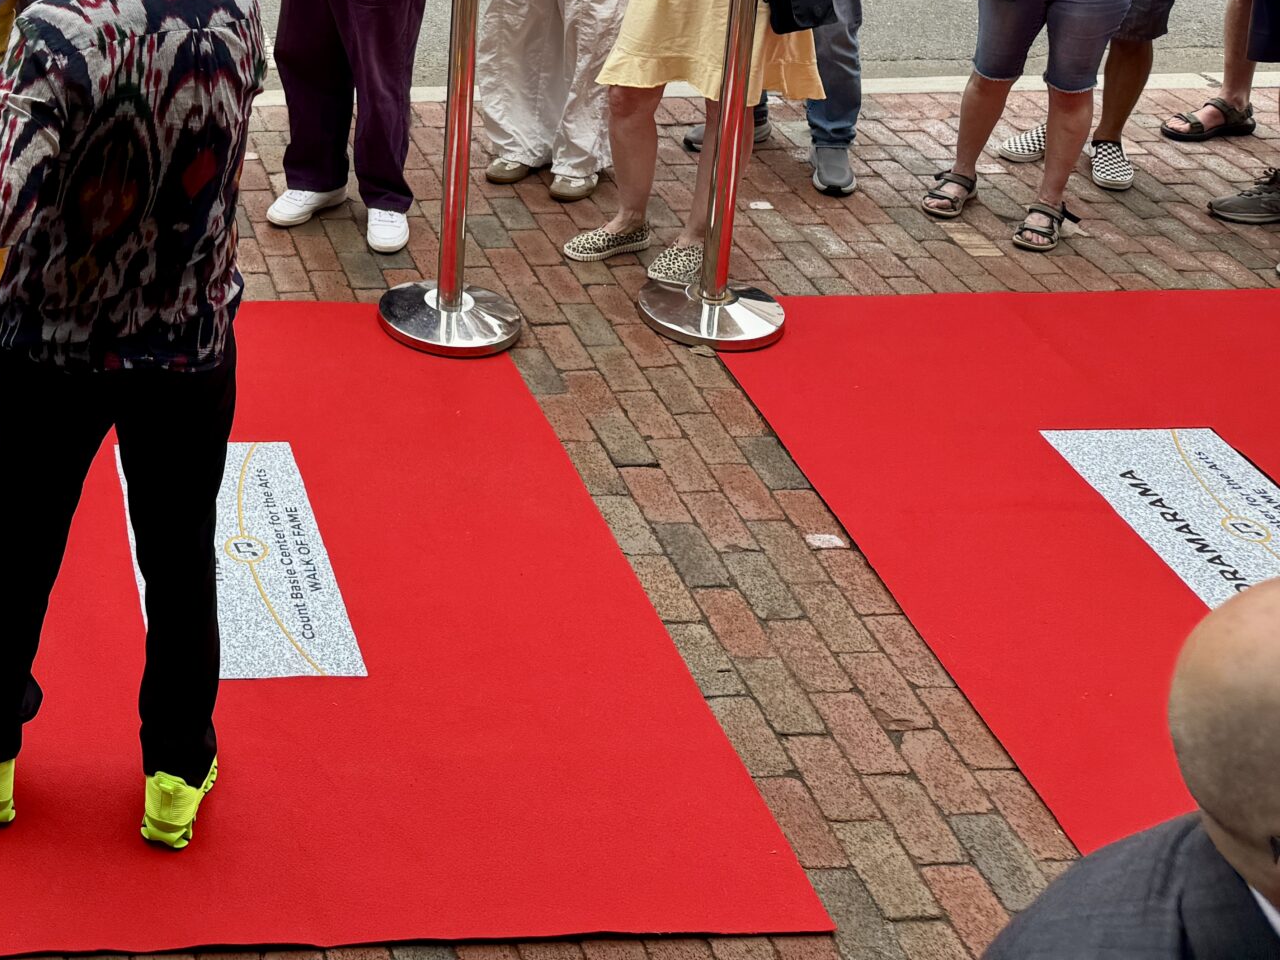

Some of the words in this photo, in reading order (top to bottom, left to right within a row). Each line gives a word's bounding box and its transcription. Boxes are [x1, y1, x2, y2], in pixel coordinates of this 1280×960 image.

[1194, 451, 1223, 472] Arts
[256, 468, 270, 489] Arts
[1220, 473, 1243, 490] the
[263, 491, 277, 510] the
[1241, 493, 1262, 507] for
[269, 509, 281, 528] for
[285, 505, 307, 538] FAME
[274, 530, 292, 566] Center
[295, 538, 311, 556] OF
[283, 567, 303, 600] Basie
[303, 558, 322, 592] WALK
[296, 602, 315, 640] Count
